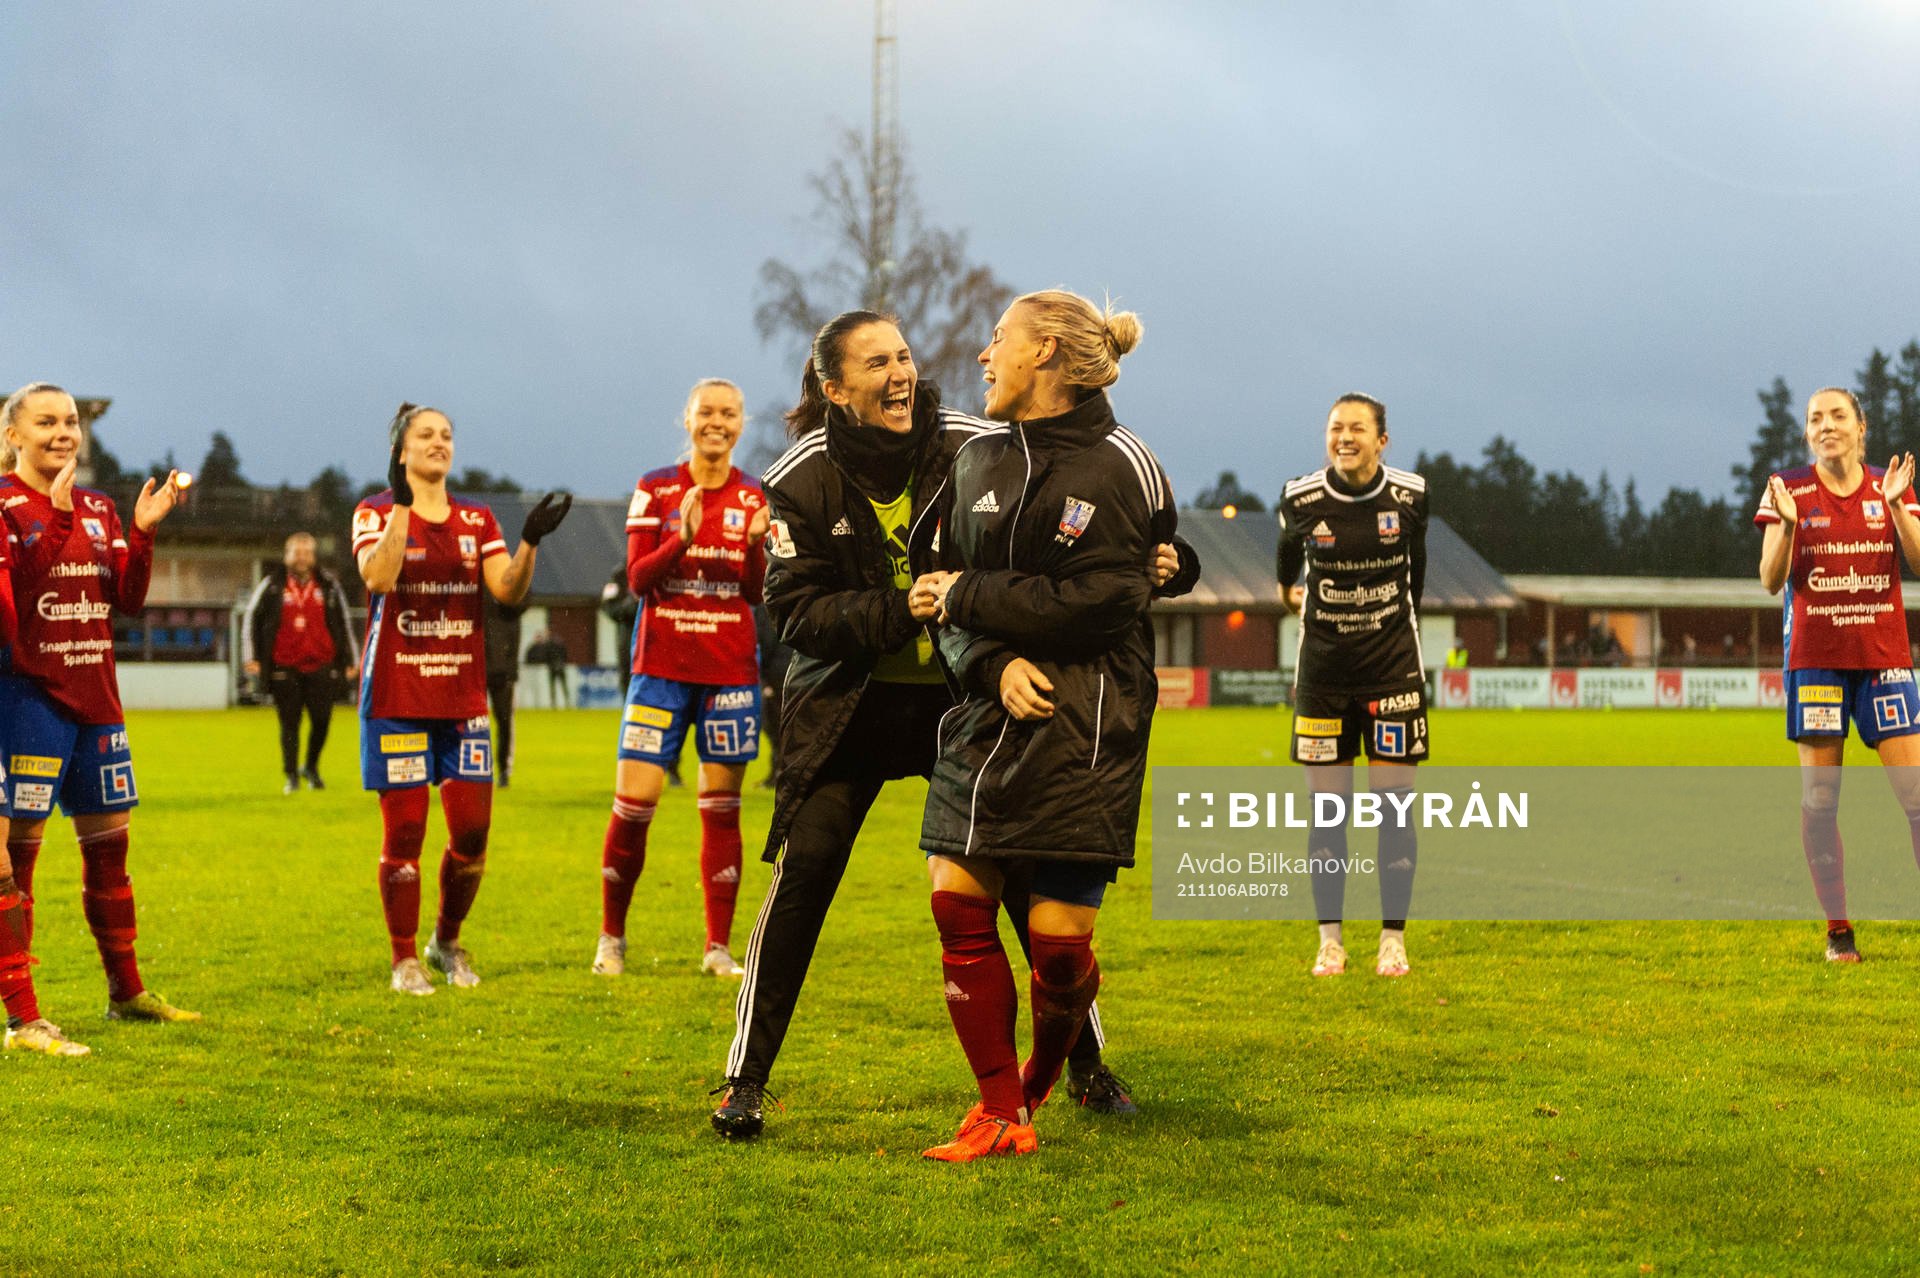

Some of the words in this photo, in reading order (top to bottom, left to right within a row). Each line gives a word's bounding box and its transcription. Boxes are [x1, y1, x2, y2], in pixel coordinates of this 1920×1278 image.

[972, 504, 1000, 513] adidas
[1807, 565, 1891, 593] Emmaljunga
[1319, 578, 1399, 606] Emmaljunga
[1806, 603, 1895, 616] Snapphanebygdens
[675, 620, 717, 633] Sparbank
[1337, 620, 1382, 634] Sparbank
[1832, 614, 1876, 627] Sparbank
[1379, 692, 1420, 711] FASAB
[744, 716, 757, 737] 2
[1412, 717, 1426, 739] 13
[13, 756, 36, 771] CITY
